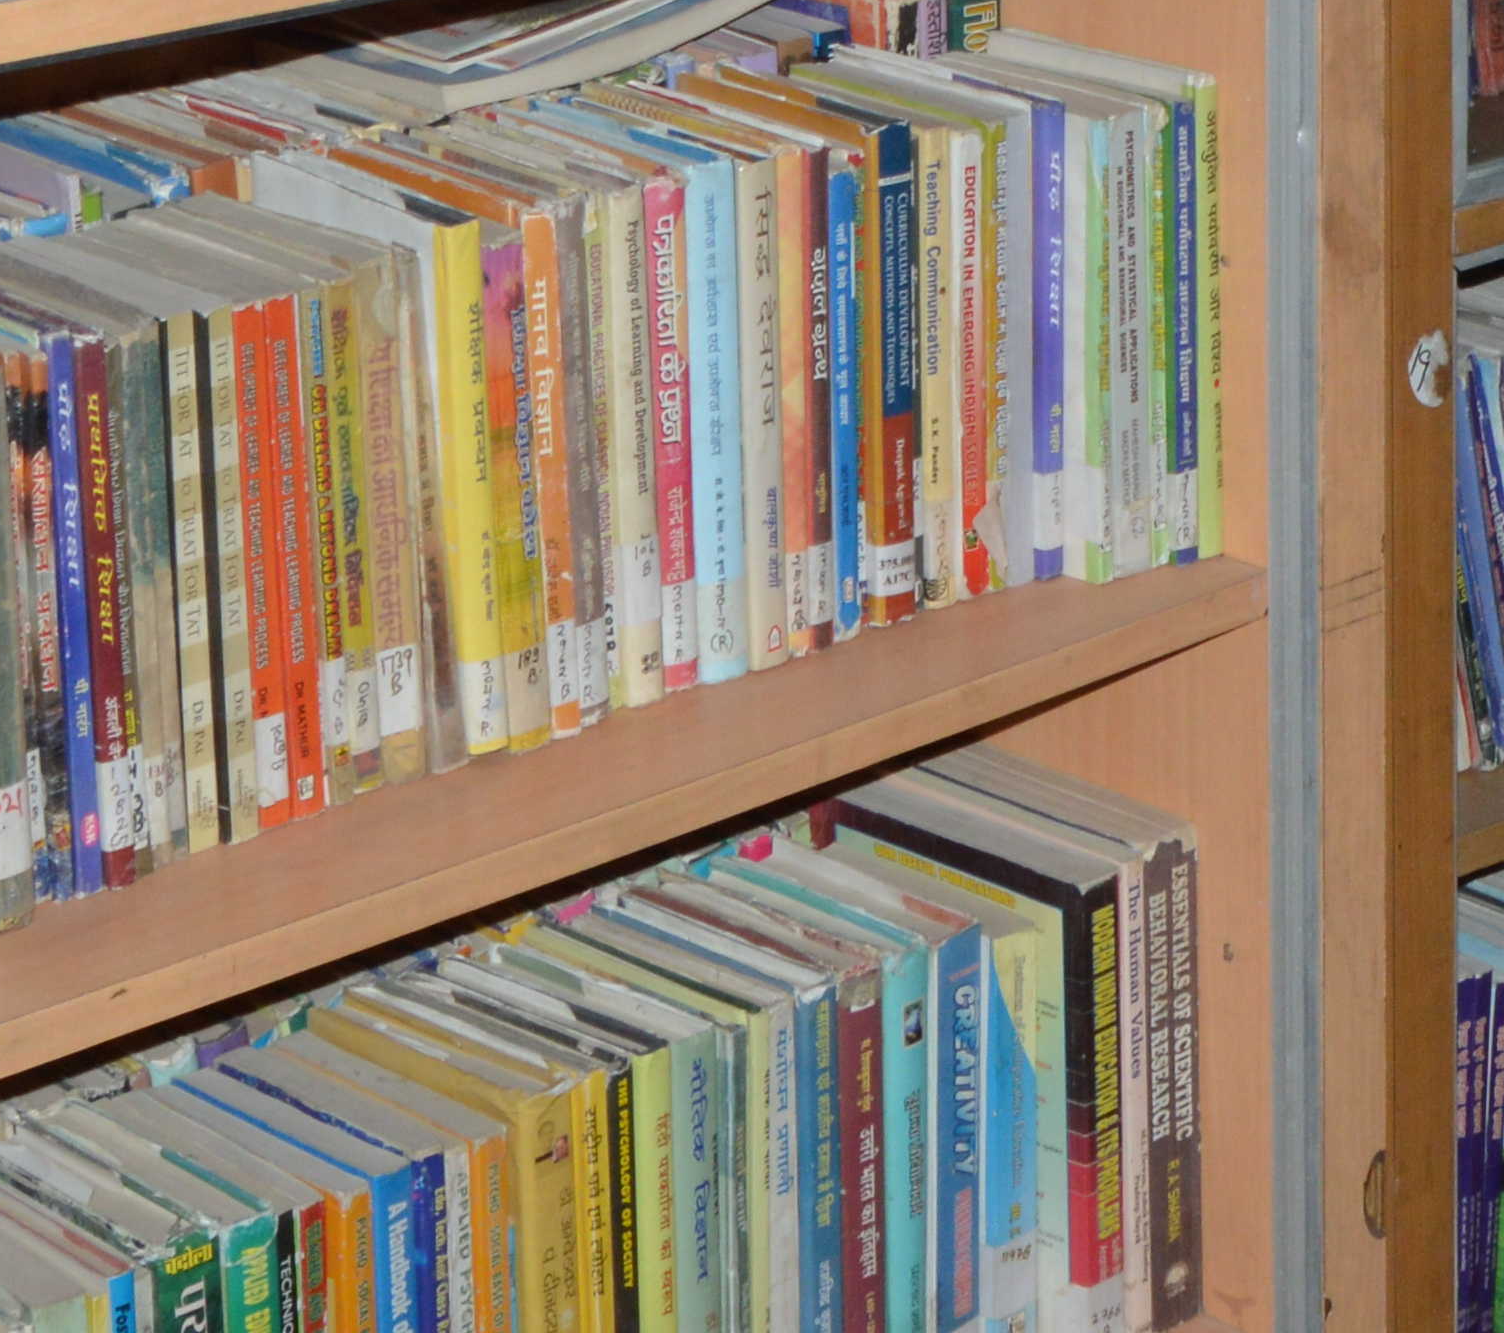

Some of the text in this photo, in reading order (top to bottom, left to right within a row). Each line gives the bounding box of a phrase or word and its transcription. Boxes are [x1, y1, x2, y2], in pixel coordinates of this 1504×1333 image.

[925, 160, 941, 377] Teaching Communication
[951, 984, 978, 1178] CREATIVITY
[1128, 884, 1143, 1080] The Human Values
[1149, 890, 1170, 1142] BEHAVIORAL RESEARCH
[1171, 863, 1193, 1142] ESSENTIALS OF SCIENTIFIC
